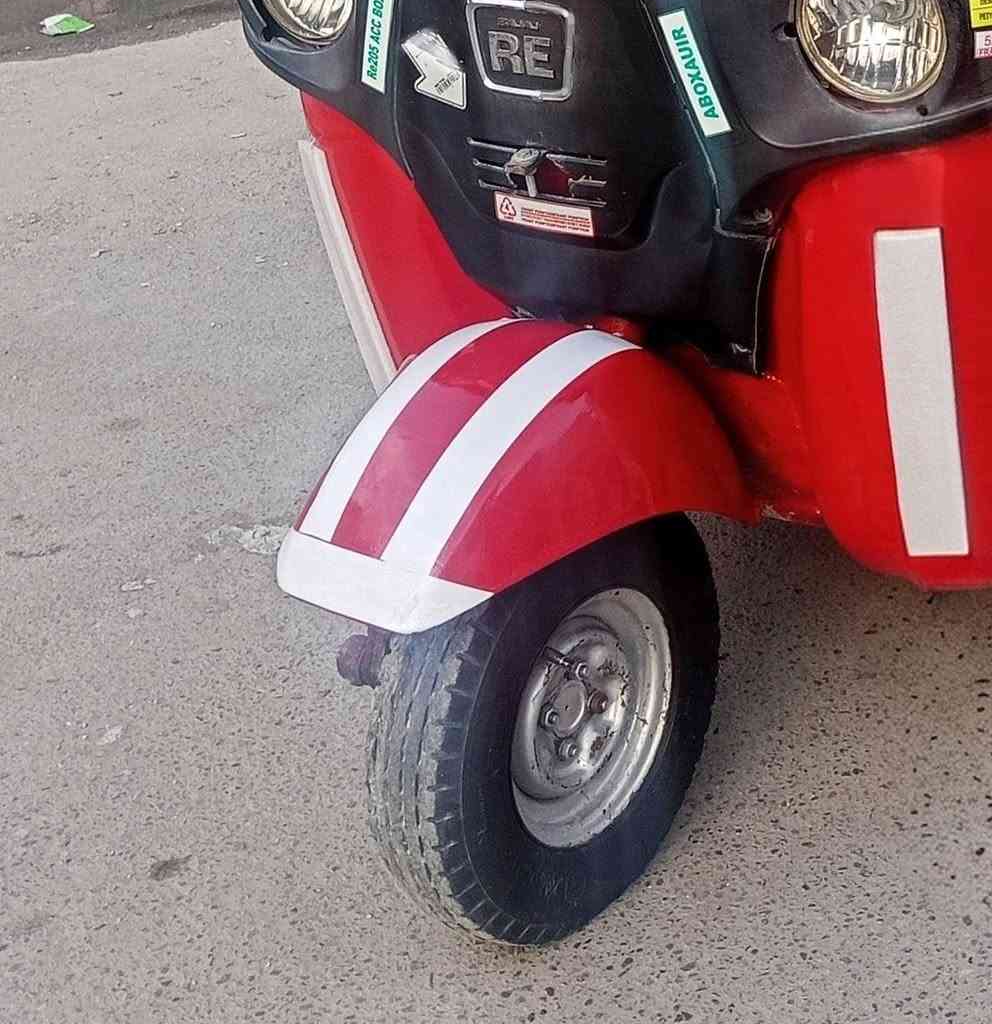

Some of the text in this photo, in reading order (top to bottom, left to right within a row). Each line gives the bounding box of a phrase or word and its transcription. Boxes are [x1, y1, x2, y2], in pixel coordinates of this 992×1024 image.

[370, 17, 382, 44] ACC
[366, 44, 379, 81] Re205
[488, 30, 554, 79] RE
[671, 26, 720, 120] ABOXAUIR
